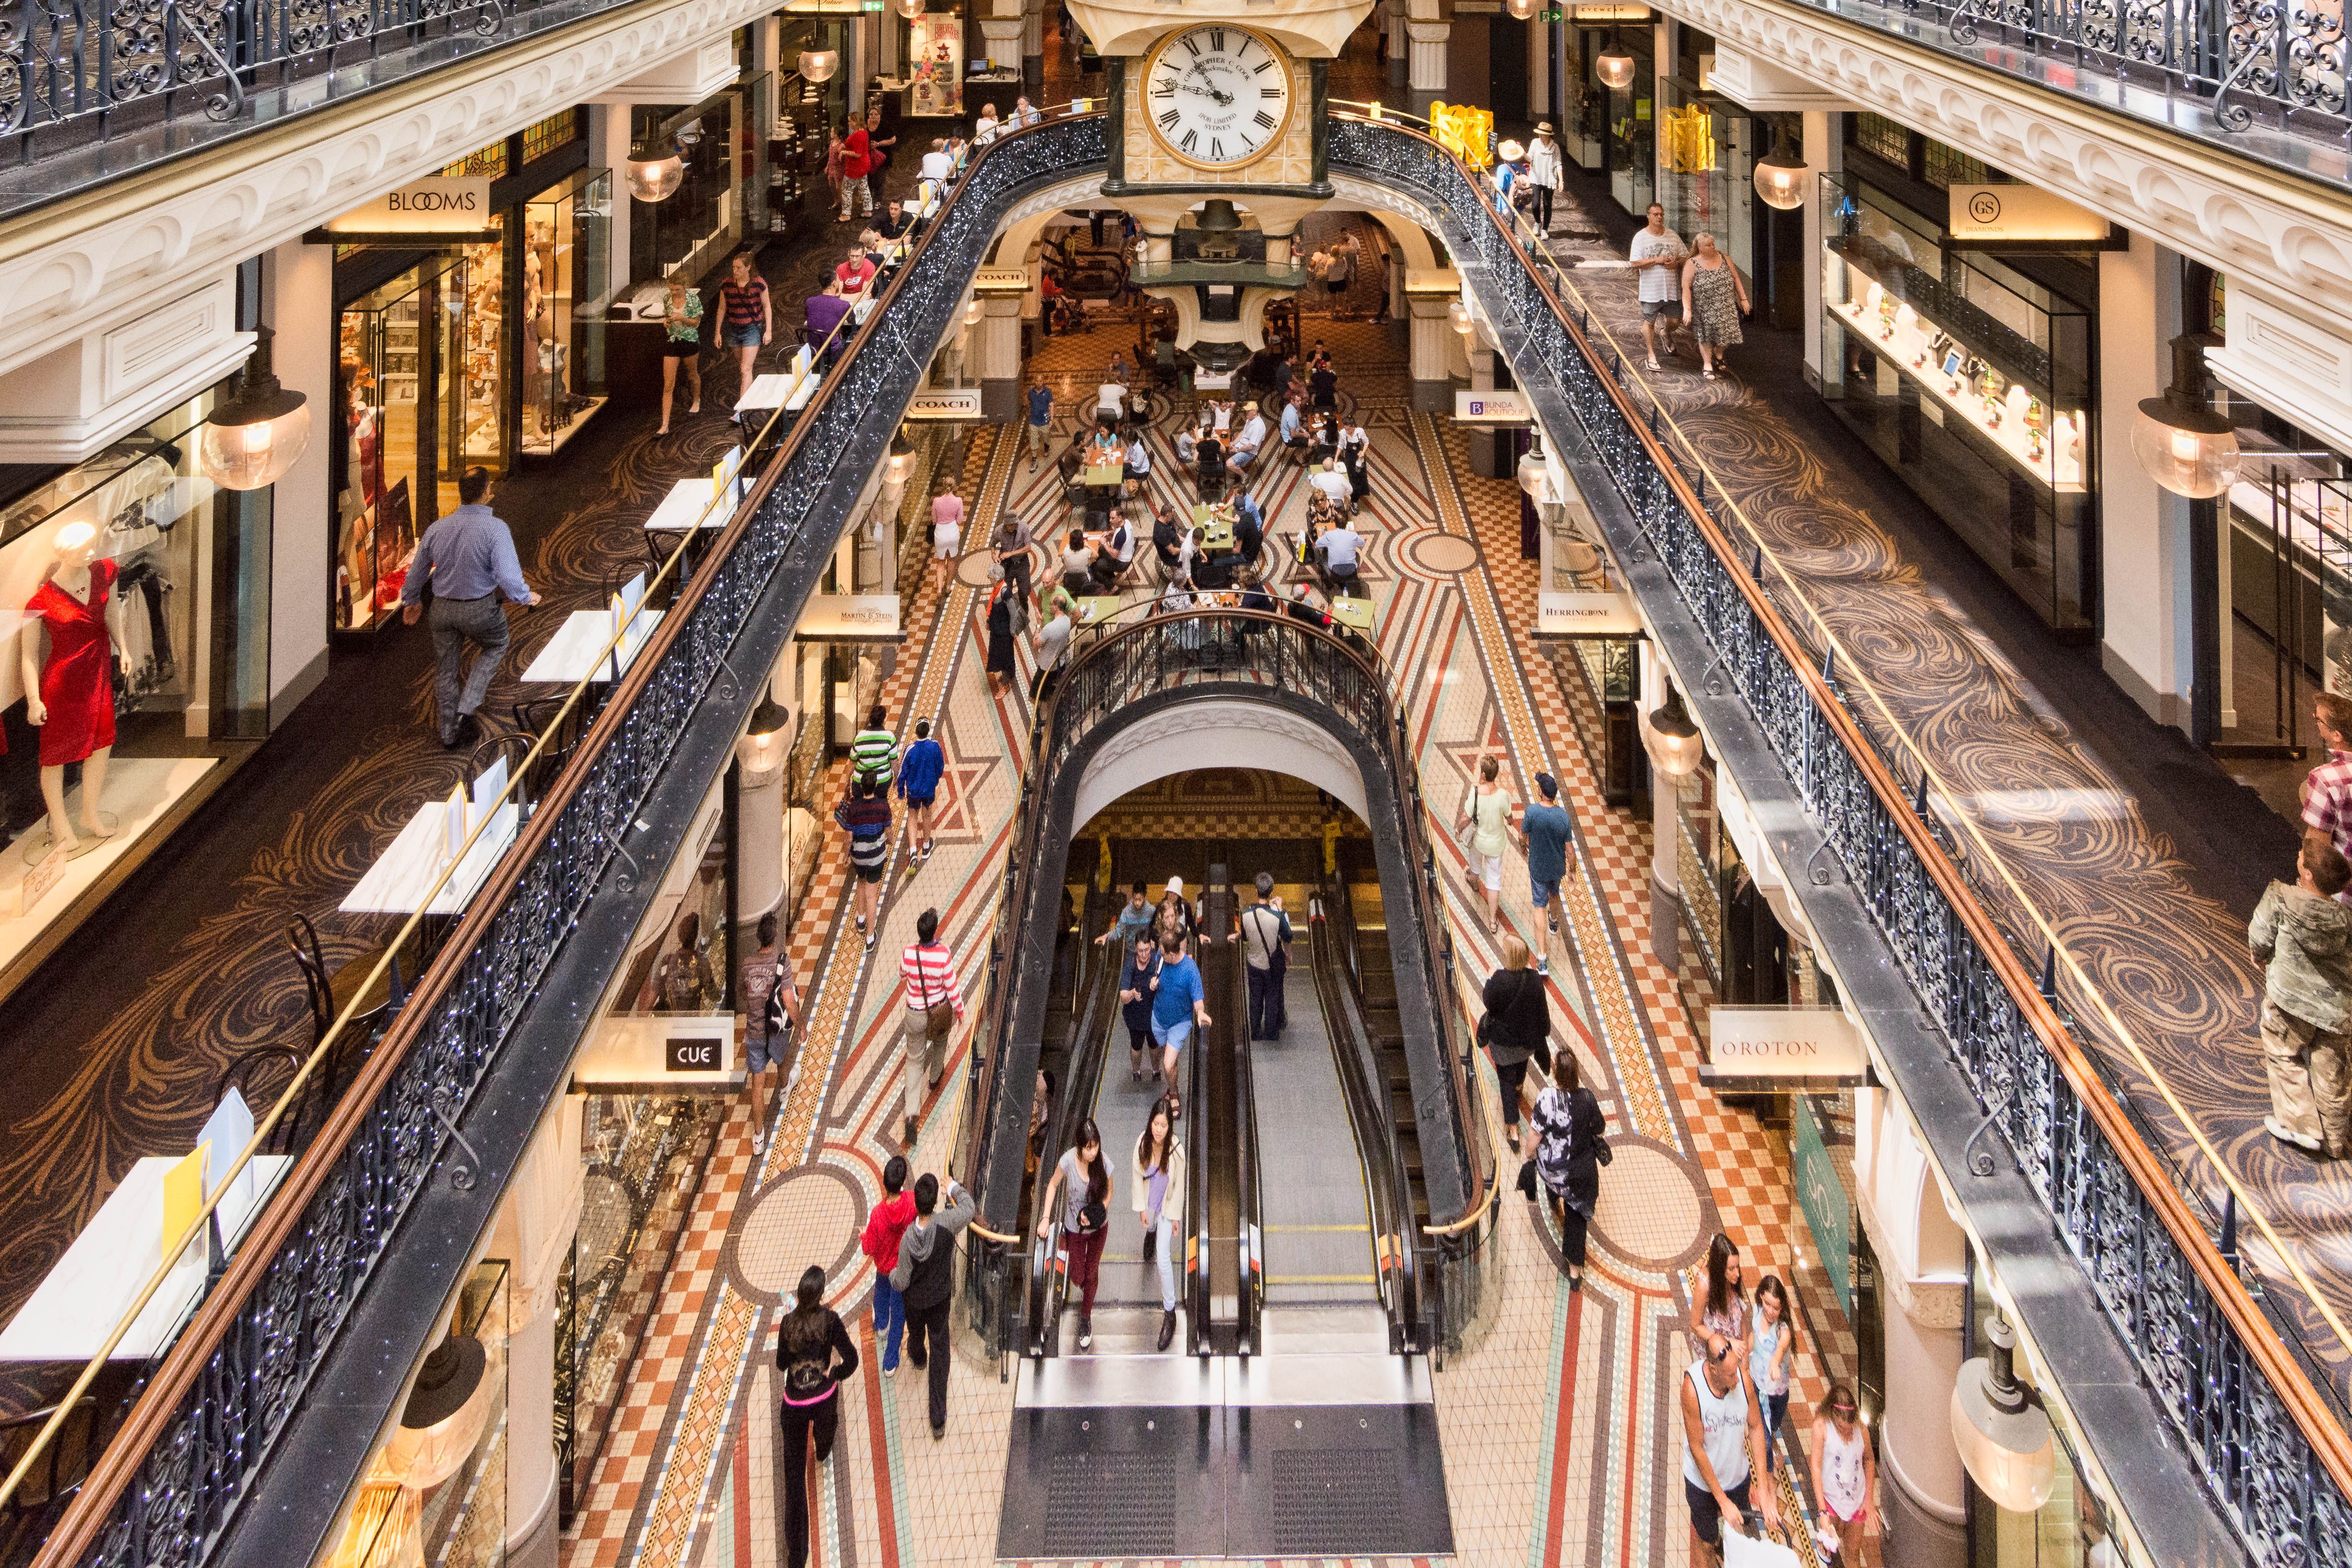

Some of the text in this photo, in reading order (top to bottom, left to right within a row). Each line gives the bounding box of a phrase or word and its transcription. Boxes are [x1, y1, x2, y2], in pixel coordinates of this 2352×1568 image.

[935, 23, 953, 32] FOREVER
[934, 30, 959, 40] CHRISTMAS
[1184, 57, 1225, 82] CHROPHER
[1236, 65, 1251, 81] COOK
[1201, 65, 1234, 74] lockmaker
[1198, 112, 1237, 123] IPOH LIMITED
[389, 192, 476, 211] BLOOMS
[1975, 201, 1994, 214] GS
[1546, 608, 1609, 617] HERRINGBONE
[36, 868, 54, 892] OFF
[677, 1047, 710, 1063] CUE
[1722, 1041, 1816, 1056] OROTON
